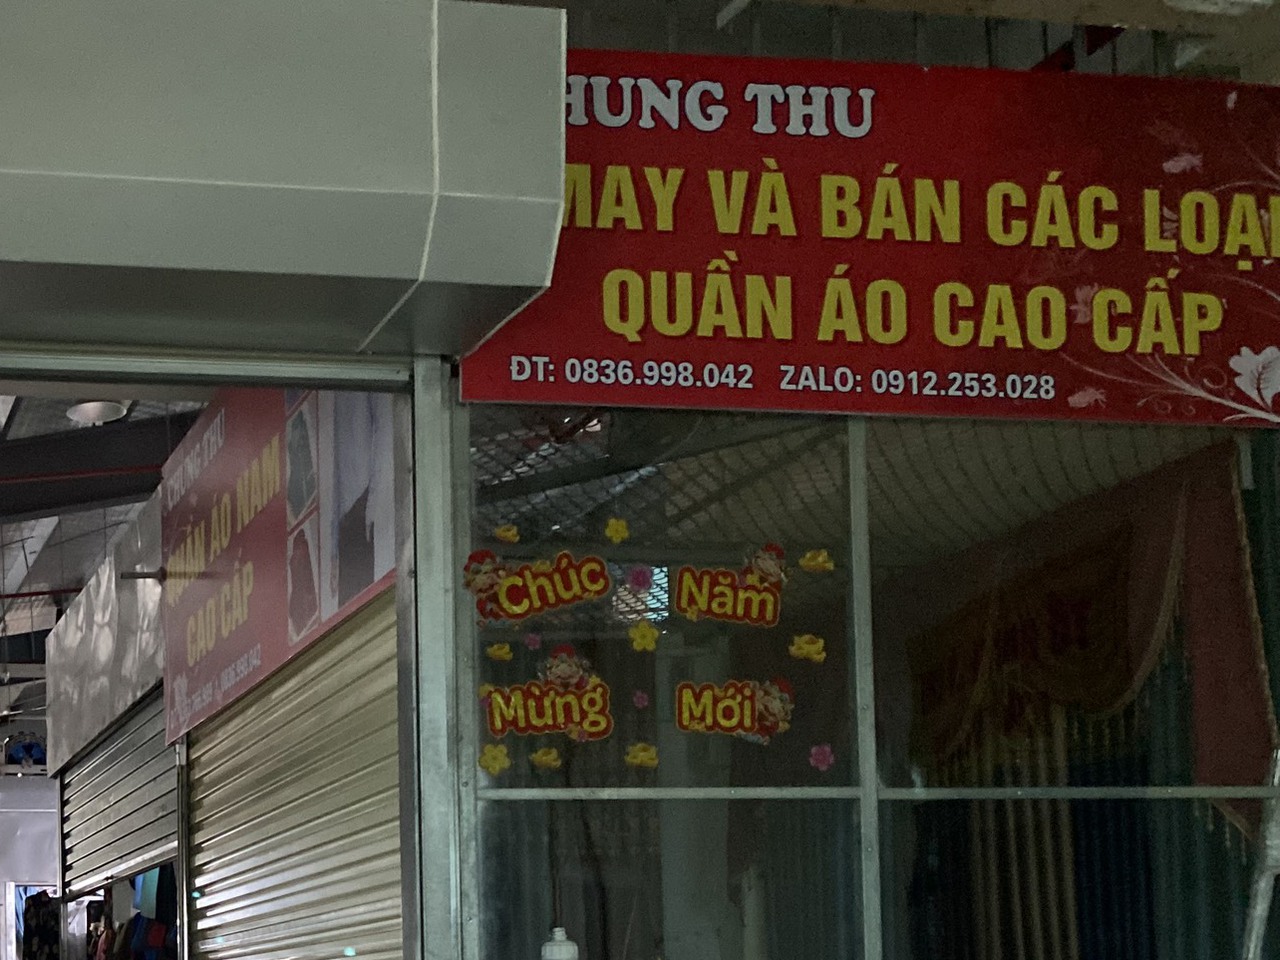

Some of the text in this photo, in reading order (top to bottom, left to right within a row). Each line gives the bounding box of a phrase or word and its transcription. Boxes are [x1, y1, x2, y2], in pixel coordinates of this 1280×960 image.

[744, 83, 875, 138] THU
[708, 157, 797, 236] VÀ
[821, 163, 961, 243] BÁN
[986, 171, 1118, 250] CÁC
[602, 250, 1223, 355] QUẦN ÁO CAO CẤP
[510, 356, 1055, 400] ĐT: 0836.998.042 ZALO: 0912.253.028
[236, 432, 281, 534] NAM
[497, 554, 775, 622] Chúc Năm
[186, 597, 216, 668] CAO
[680, 686, 756, 727] Mới
